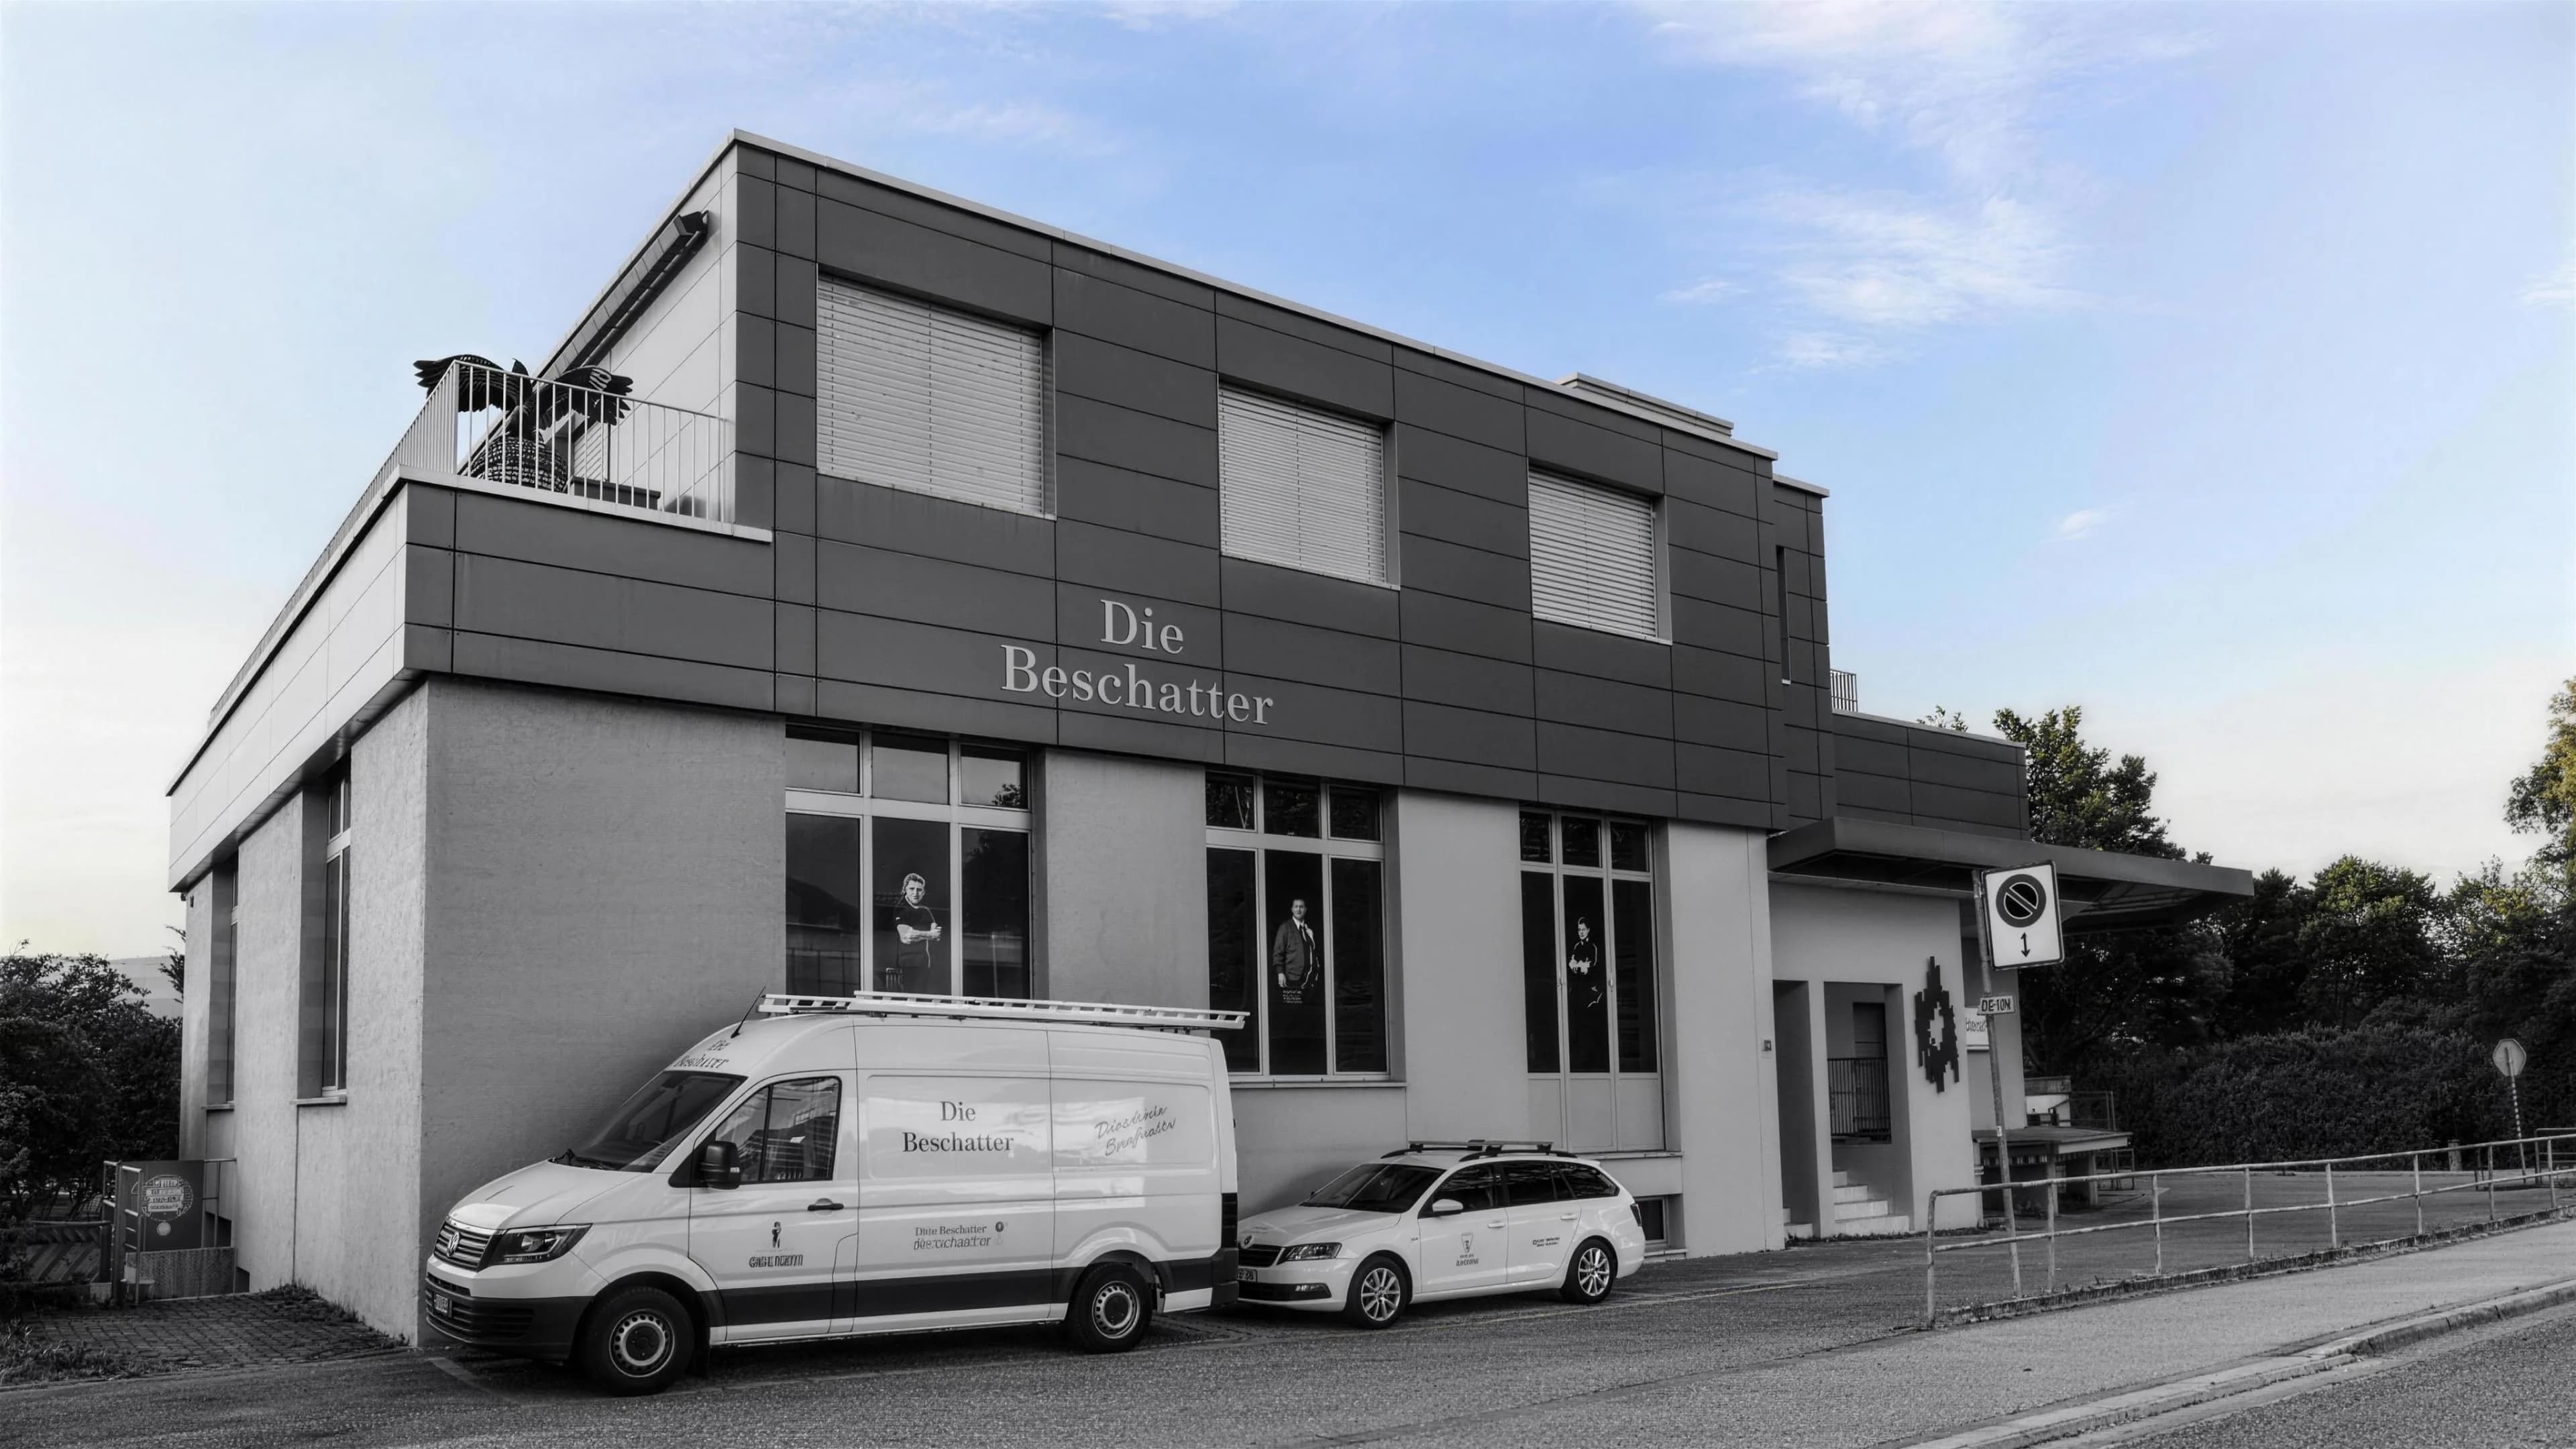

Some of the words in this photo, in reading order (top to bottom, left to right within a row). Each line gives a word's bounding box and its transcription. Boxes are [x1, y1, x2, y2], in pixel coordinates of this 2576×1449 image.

[1100, 599, 1183, 653] Die
[1000, 644, 1273, 724] Beschatter
[940, 1101, 976, 1122] Die
[902, 1132, 1014, 1153] Beschatter
